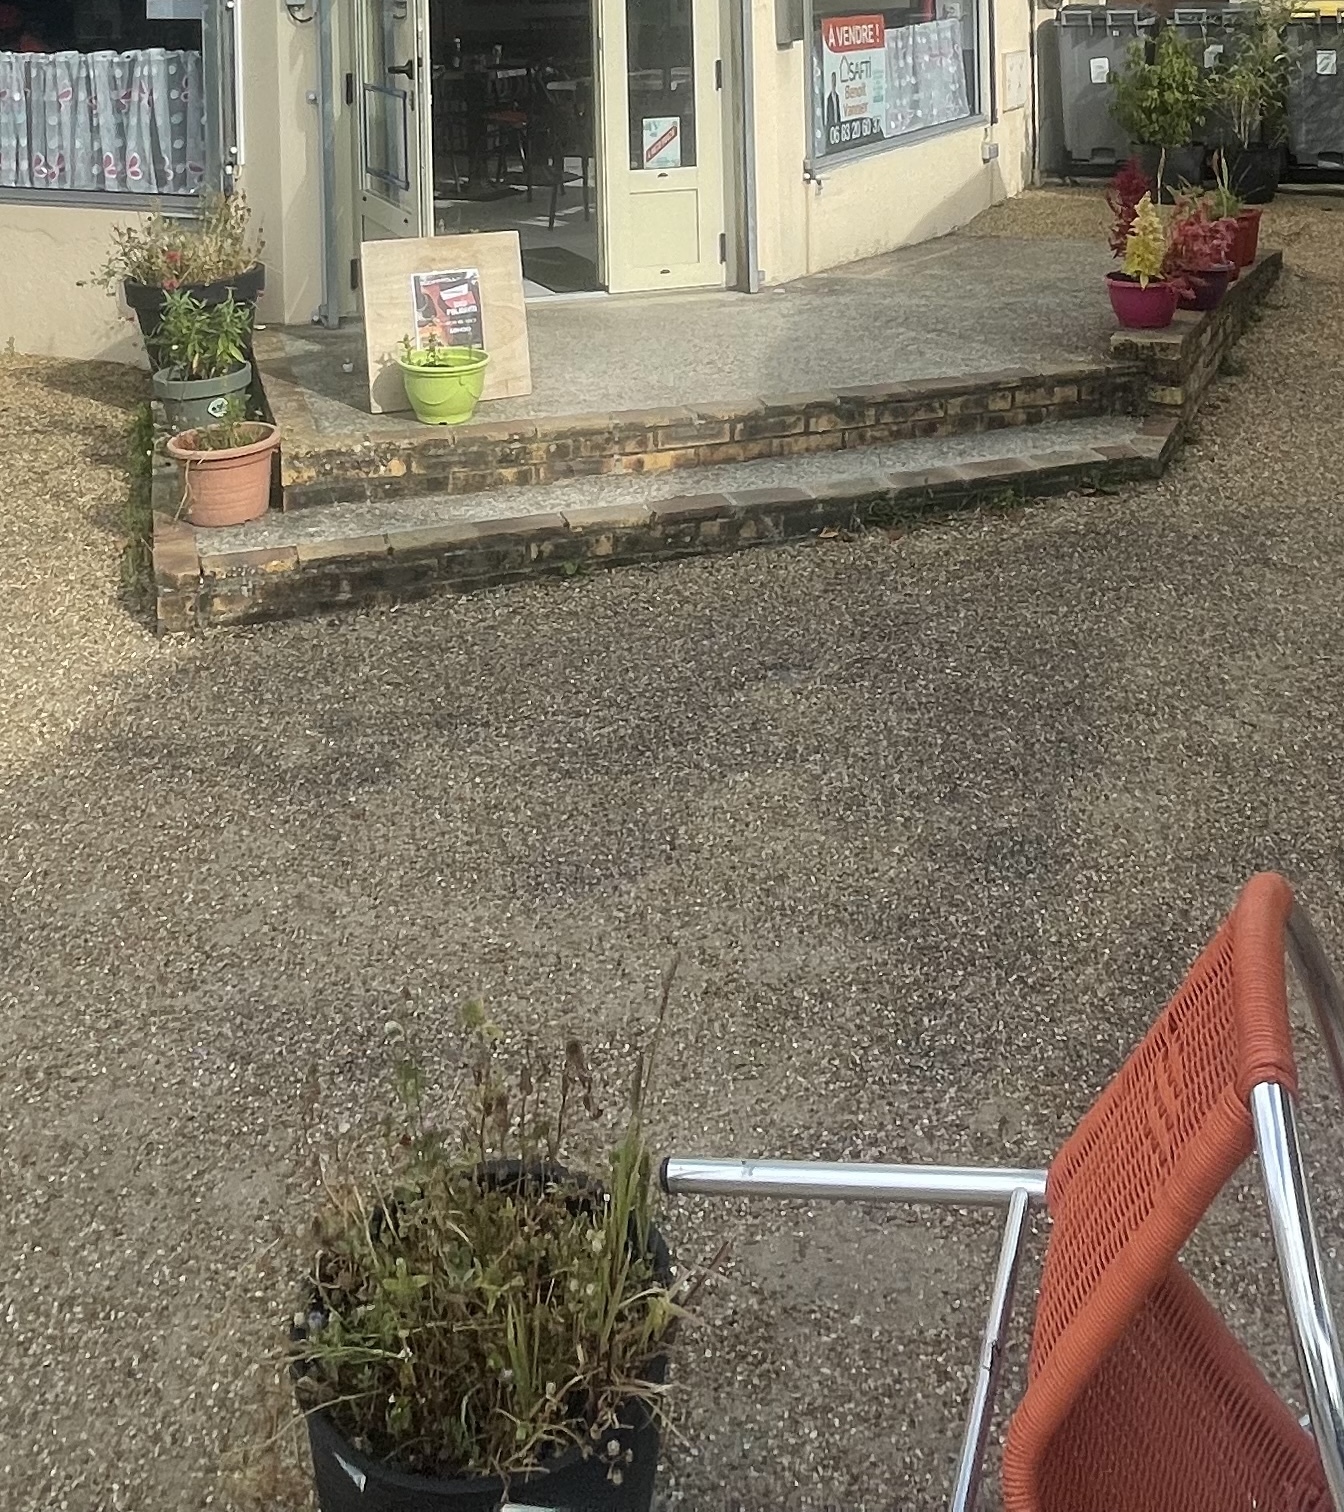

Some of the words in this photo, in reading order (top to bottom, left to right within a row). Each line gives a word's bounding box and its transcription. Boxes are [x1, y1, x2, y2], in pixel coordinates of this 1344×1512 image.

[836, 24, 874, 47] VENDRE
[829, 126, 840, 145] 06
[851, 120, 861, 140] 20
